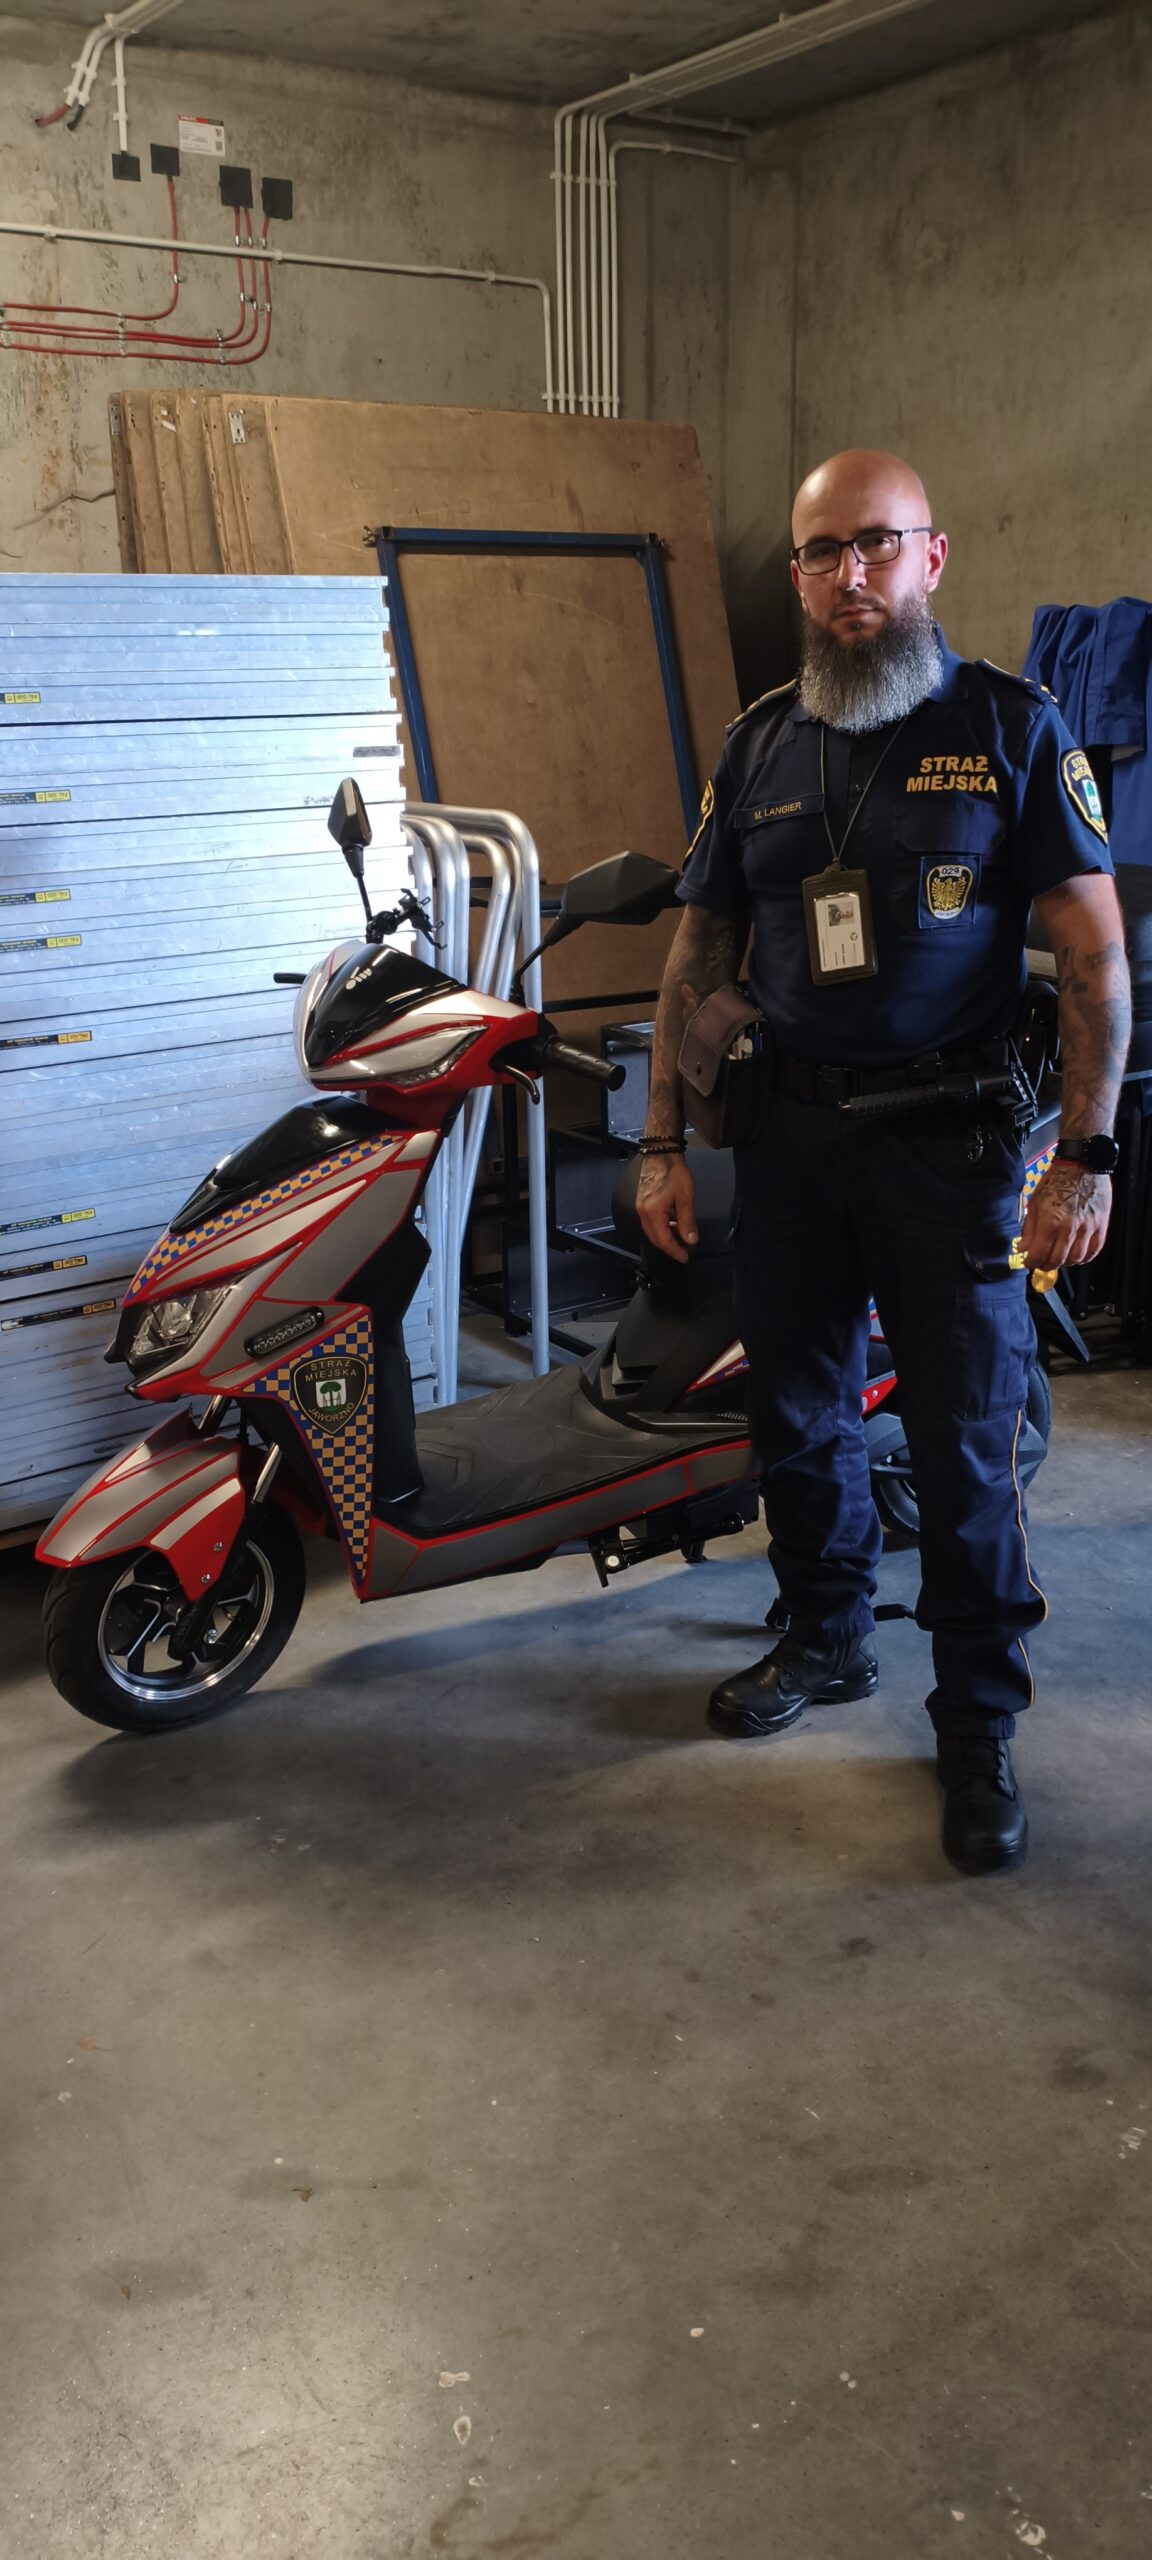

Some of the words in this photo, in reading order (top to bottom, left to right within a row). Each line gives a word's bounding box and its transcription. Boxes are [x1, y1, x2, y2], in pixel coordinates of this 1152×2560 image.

[906, 774, 998, 792] MIEJSKA
[764, 801, 802, 817] LANGIER
[941, 867, 960, 875] 029
[305, 1369, 357, 1383] MIEJSKA
[308, 1402, 355, 1422] JAWORZNO
